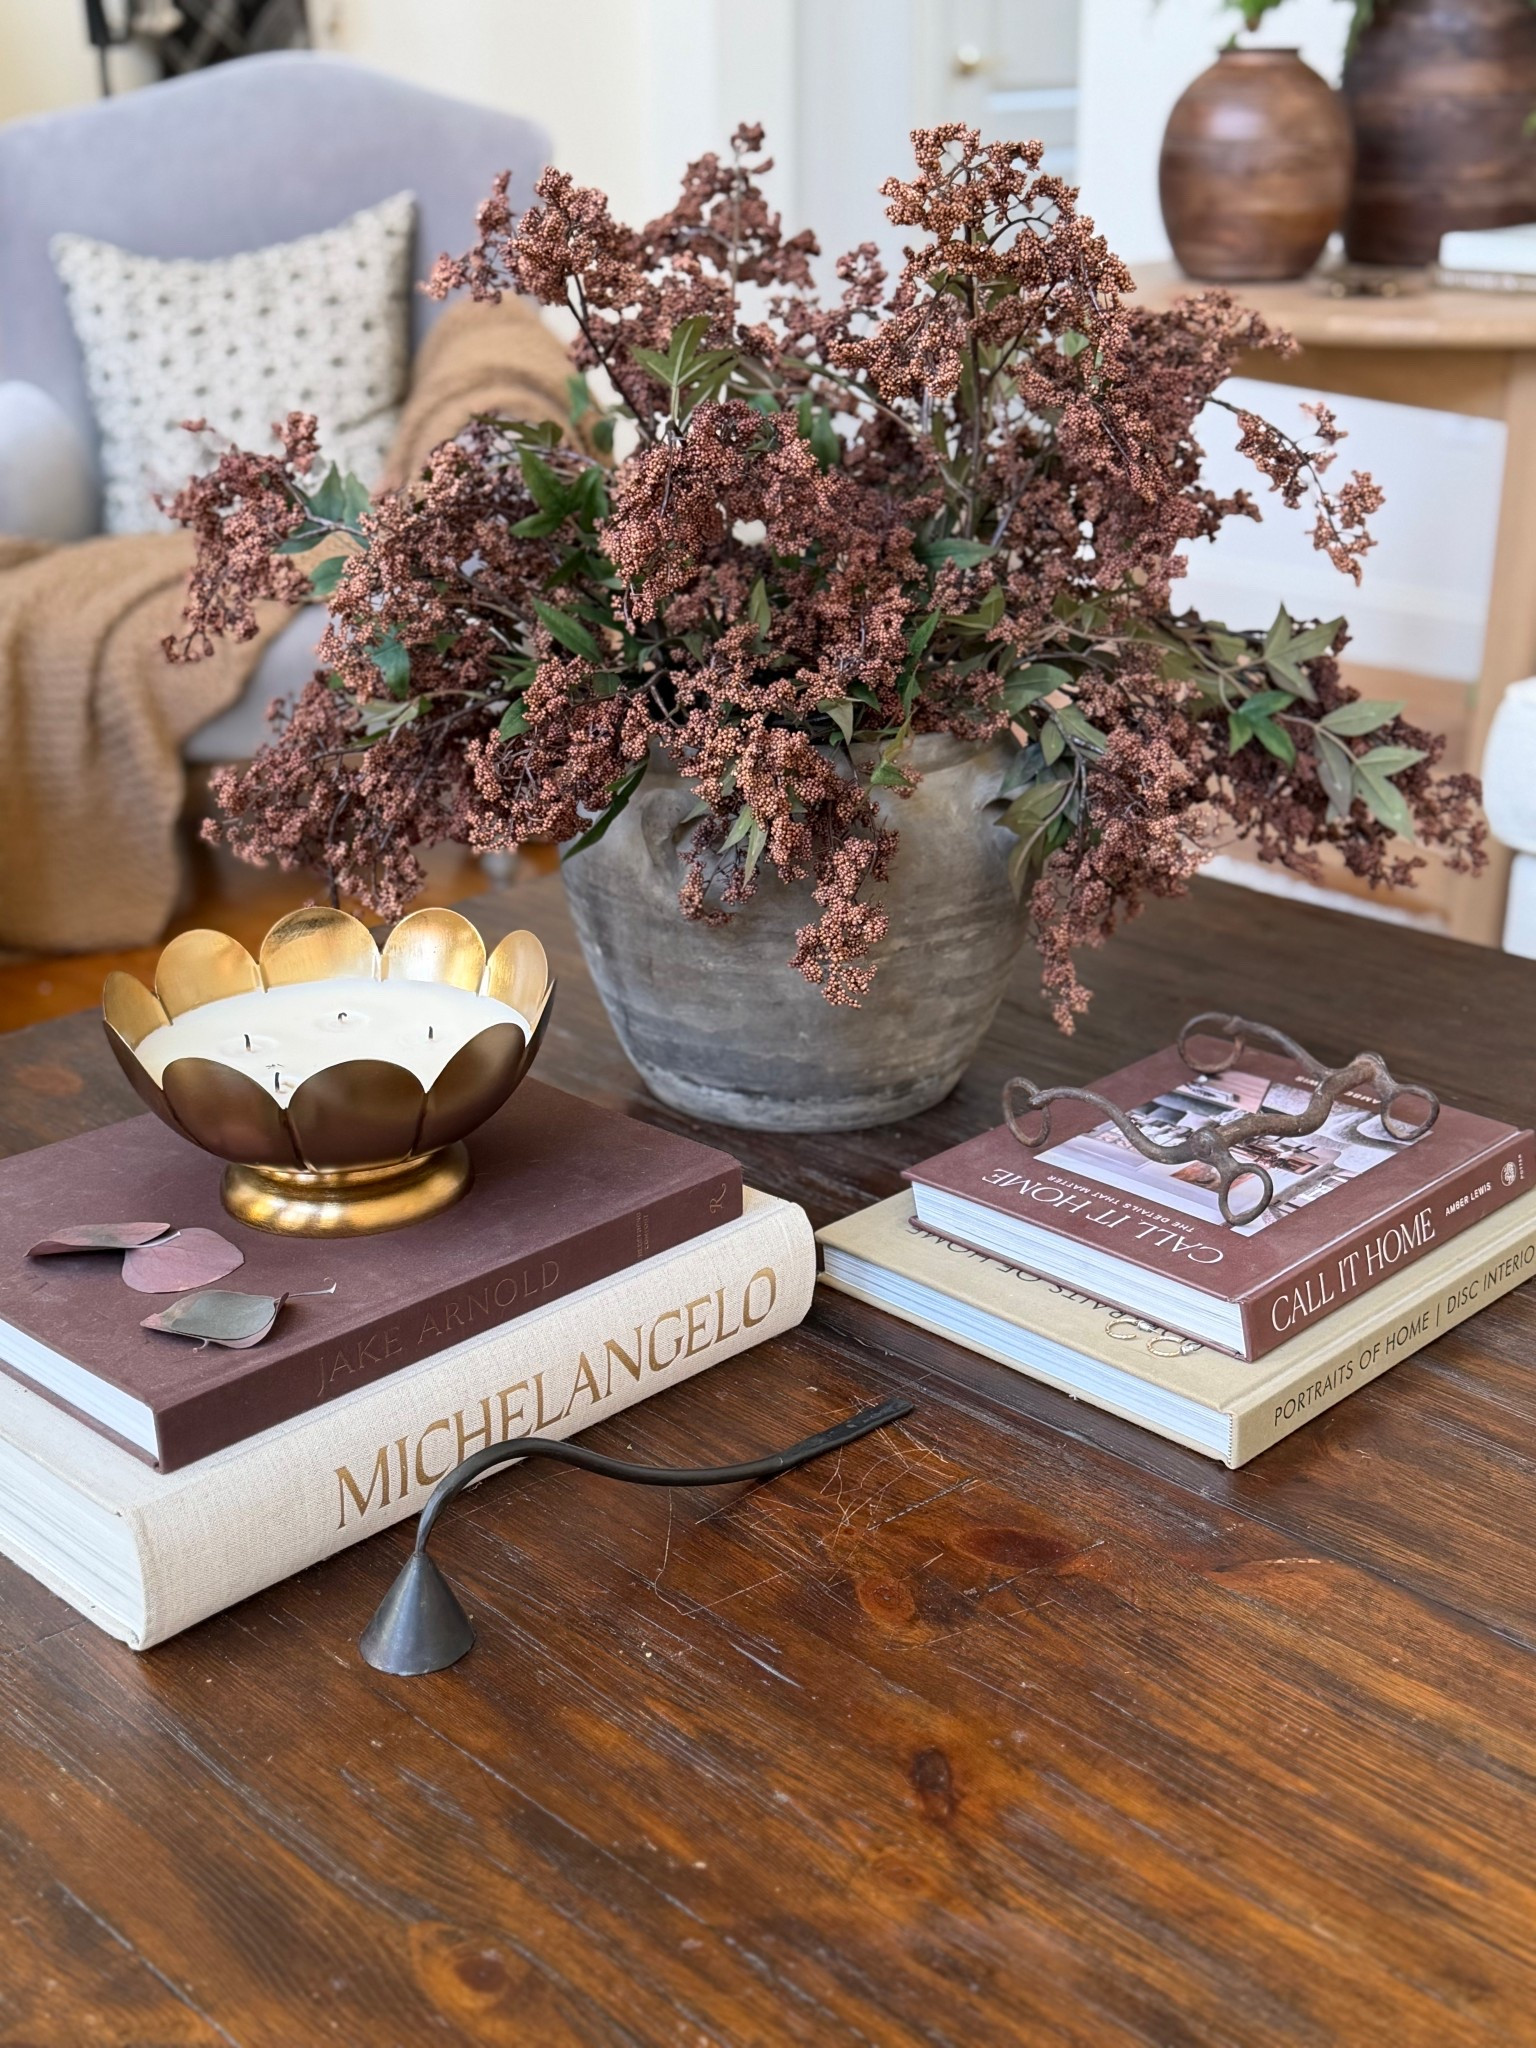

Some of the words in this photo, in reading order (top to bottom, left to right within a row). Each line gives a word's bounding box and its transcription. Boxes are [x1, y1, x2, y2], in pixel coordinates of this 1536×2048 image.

[981, 1168, 1092, 1215] HOME
[1046, 1175, 1092, 1195] MATTER
[1091, 1192, 1121, 1207] THAT
[1445, 1195, 1470, 1217] AMBER
[1470, 1181, 1492, 1201] LEWIS
[1085, 1208, 1131, 1230] IT
[1122, 1203, 1169, 1224] DETAILS
[1171, 1220, 1195, 1234] THE
[1135, 1220, 1225, 1265] CALL
[1271, 1272, 1335, 1332] CALL
[1337, 1251, 1360, 1294] IT
[1364, 1207, 1436, 1277] HOME
[316, 1327, 403, 1397] JAKE
[417, 1260, 560, 1344] ARNOLD
[1274, 1360, 1354, 1427] PORTRAITS
[1358, 1342, 1381, 1370] OF
[1385, 1311, 1430, 1355] HOME
[1447, 1280, 1479, 1315] DISC
[1483, 1245, 1535, 1292] INTERIO
[335, 1267, 777, 1529] MICHELANGELO
